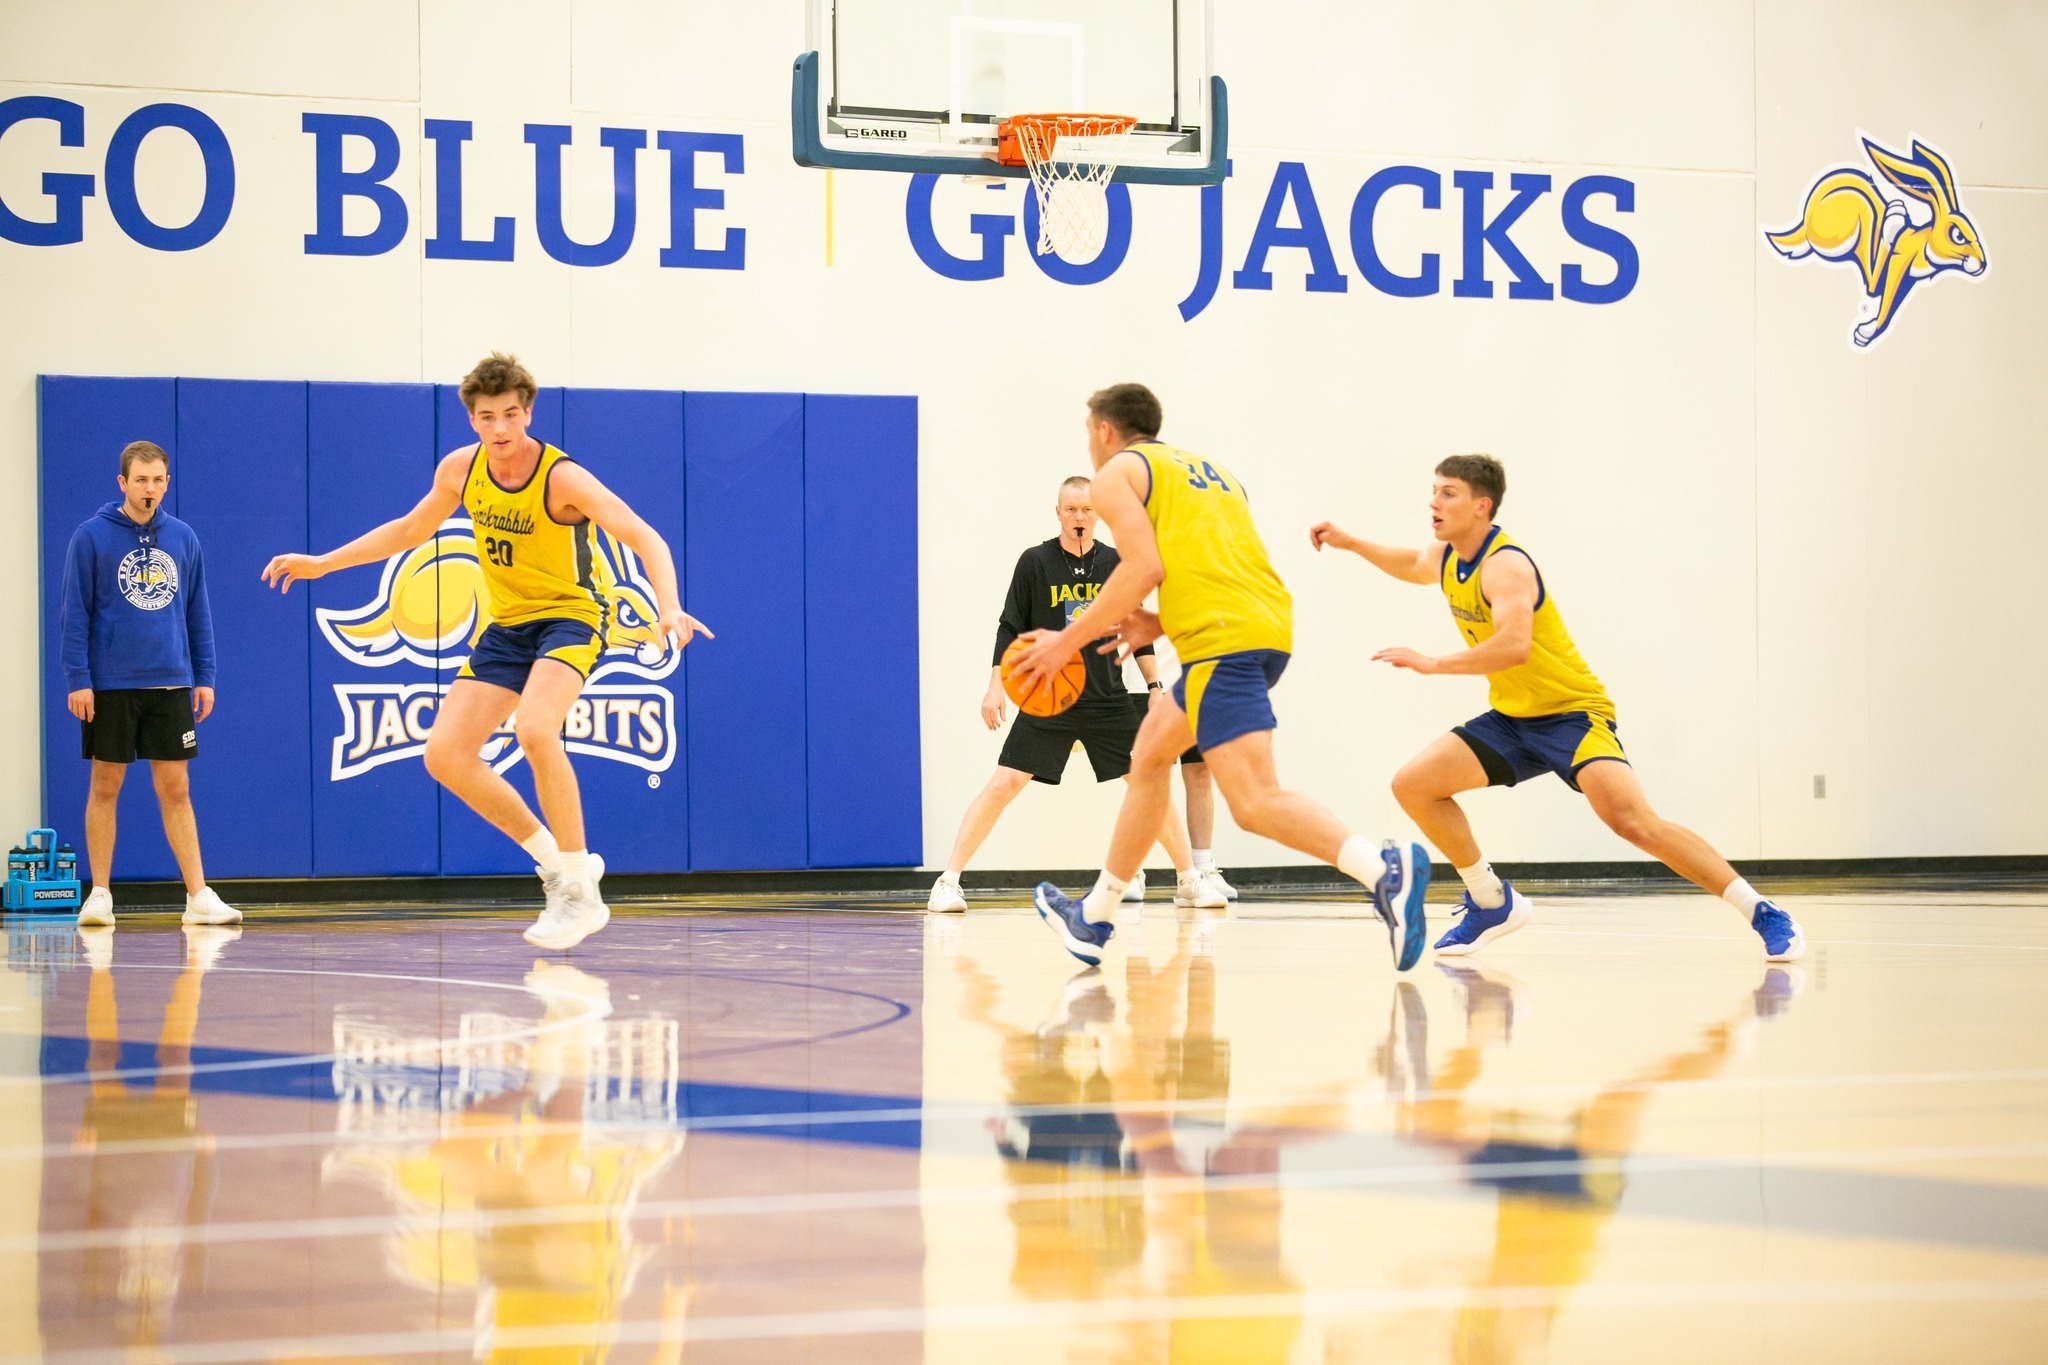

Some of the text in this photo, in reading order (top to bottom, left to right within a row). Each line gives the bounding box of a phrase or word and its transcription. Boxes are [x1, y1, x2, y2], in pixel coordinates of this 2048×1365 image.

[860, 128, 907, 138] GARED
[0, 96, 747, 270] GO BLUE
[905, 158, 1640, 323] GO JACKS
[1187, 460, 1231, 492] 34
[485, 536, 513, 567] 20
[1050, 583, 1102, 607] JACK
[348, 696, 664, 761] JACBITS
[34, 889, 76, 899] POWERADE
